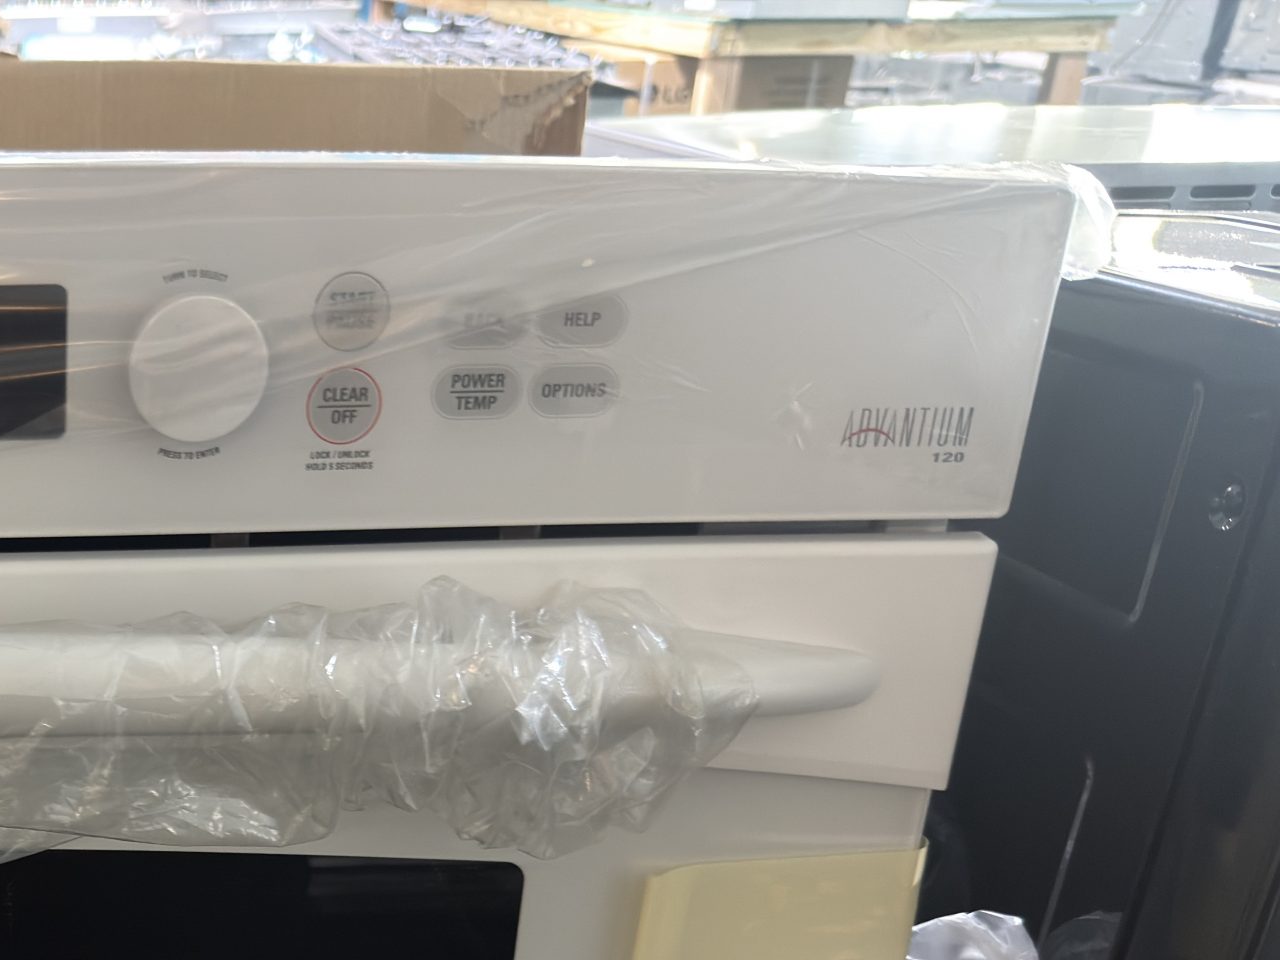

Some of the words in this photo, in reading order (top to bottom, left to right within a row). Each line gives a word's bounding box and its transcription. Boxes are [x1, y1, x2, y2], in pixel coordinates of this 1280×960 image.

[564, 312, 602, 327] HELP
[451, 374, 506, 389] POWER
[322, 387, 369, 402] CLEAR
[541, 383, 607, 398] OPTIONS
[455, 396, 498, 410] TEMP
[331, 409, 358, 424] OFF
[840, 406, 975, 447] ADVANTIUM
[932, 452, 965, 463] 120
